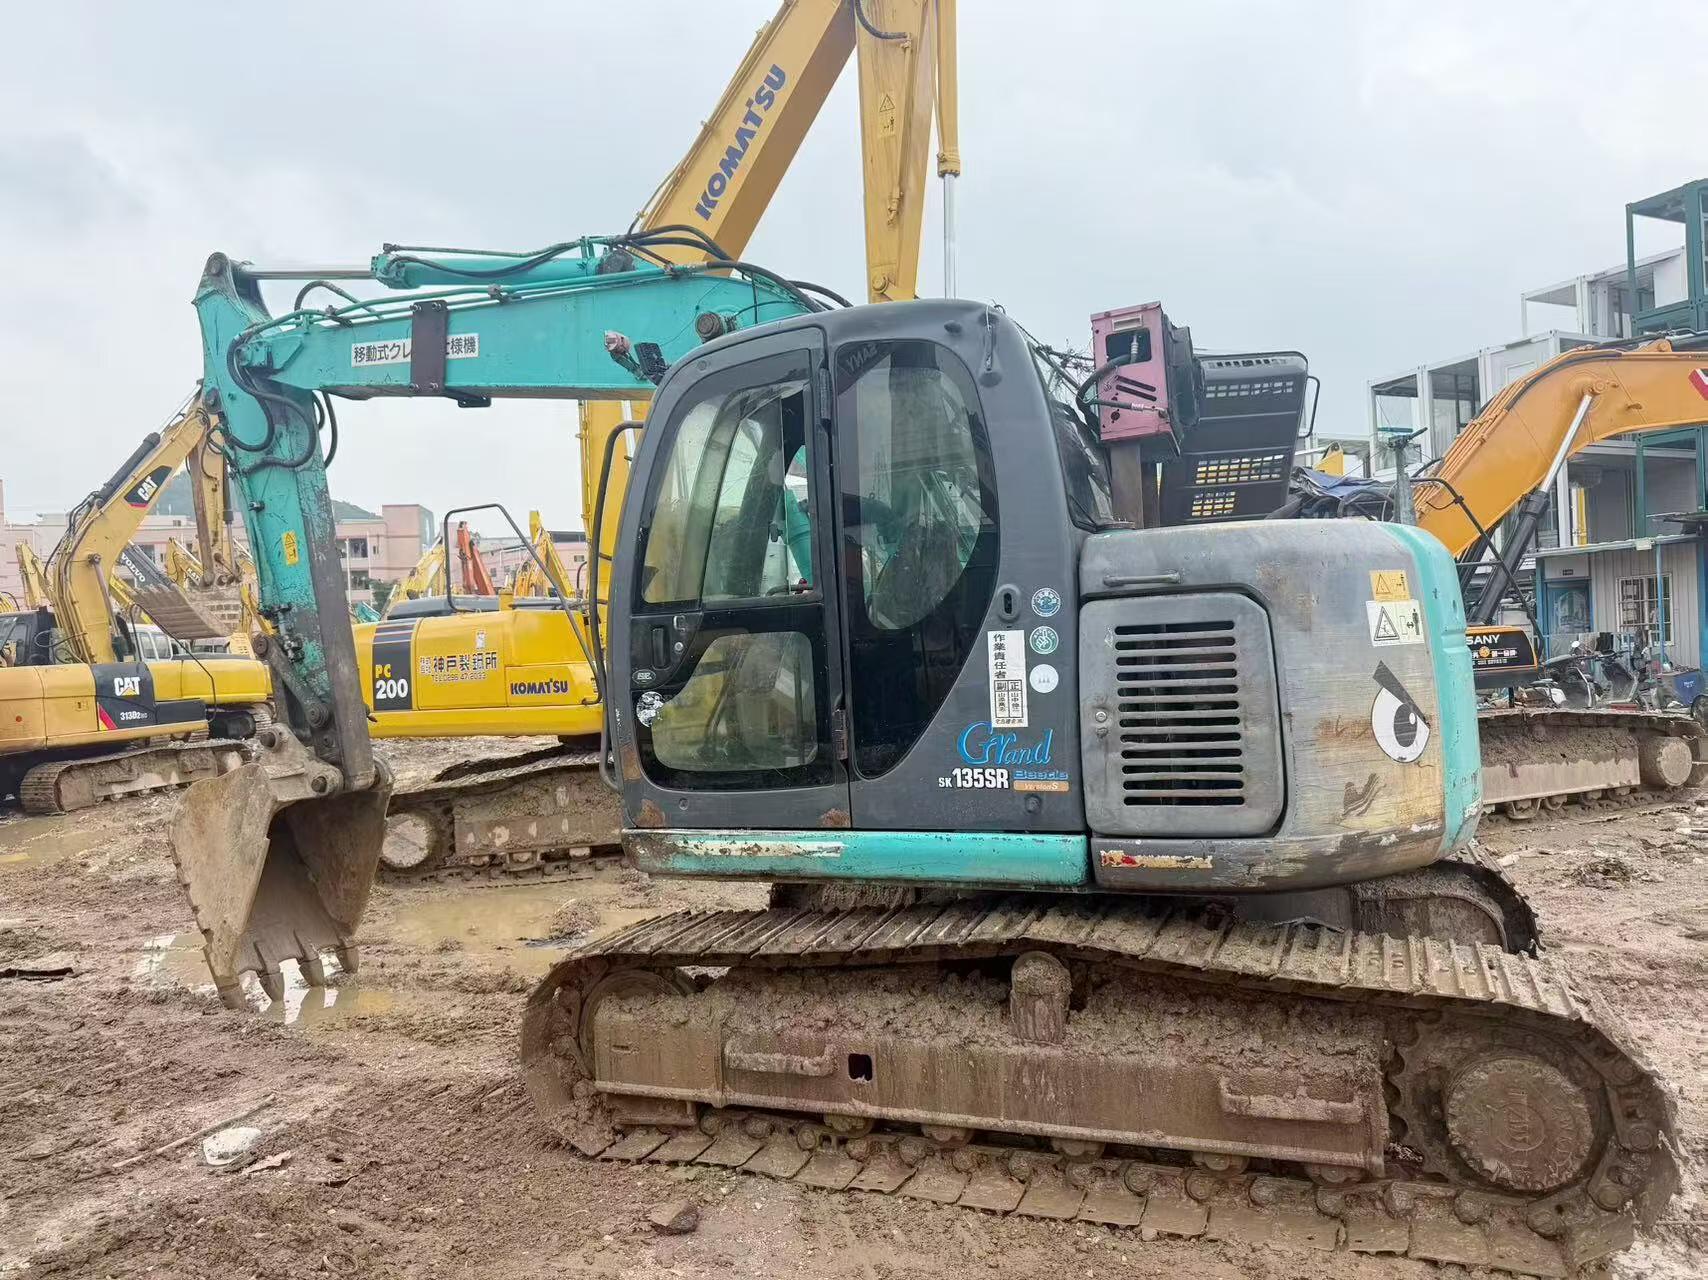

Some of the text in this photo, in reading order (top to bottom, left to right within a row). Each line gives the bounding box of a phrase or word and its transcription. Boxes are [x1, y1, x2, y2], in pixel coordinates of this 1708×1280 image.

[694, 63, 788, 222] KOMATSU
[354, 336, 477, 362] 移動式クレ様機
[137, 475, 158, 501] CAT
[121, 551, 146, 583] VOLVO
[1466, 633, 1500, 645] SANY
[993, 633, 1007, 679] 作業責任者
[375, 664, 392, 679] PC
[114, 676, 141, 696] CAT
[374, 678, 409, 699] 200
[510, 678, 568, 695] KOMATSU
[957, 720, 1053, 765] Grand
